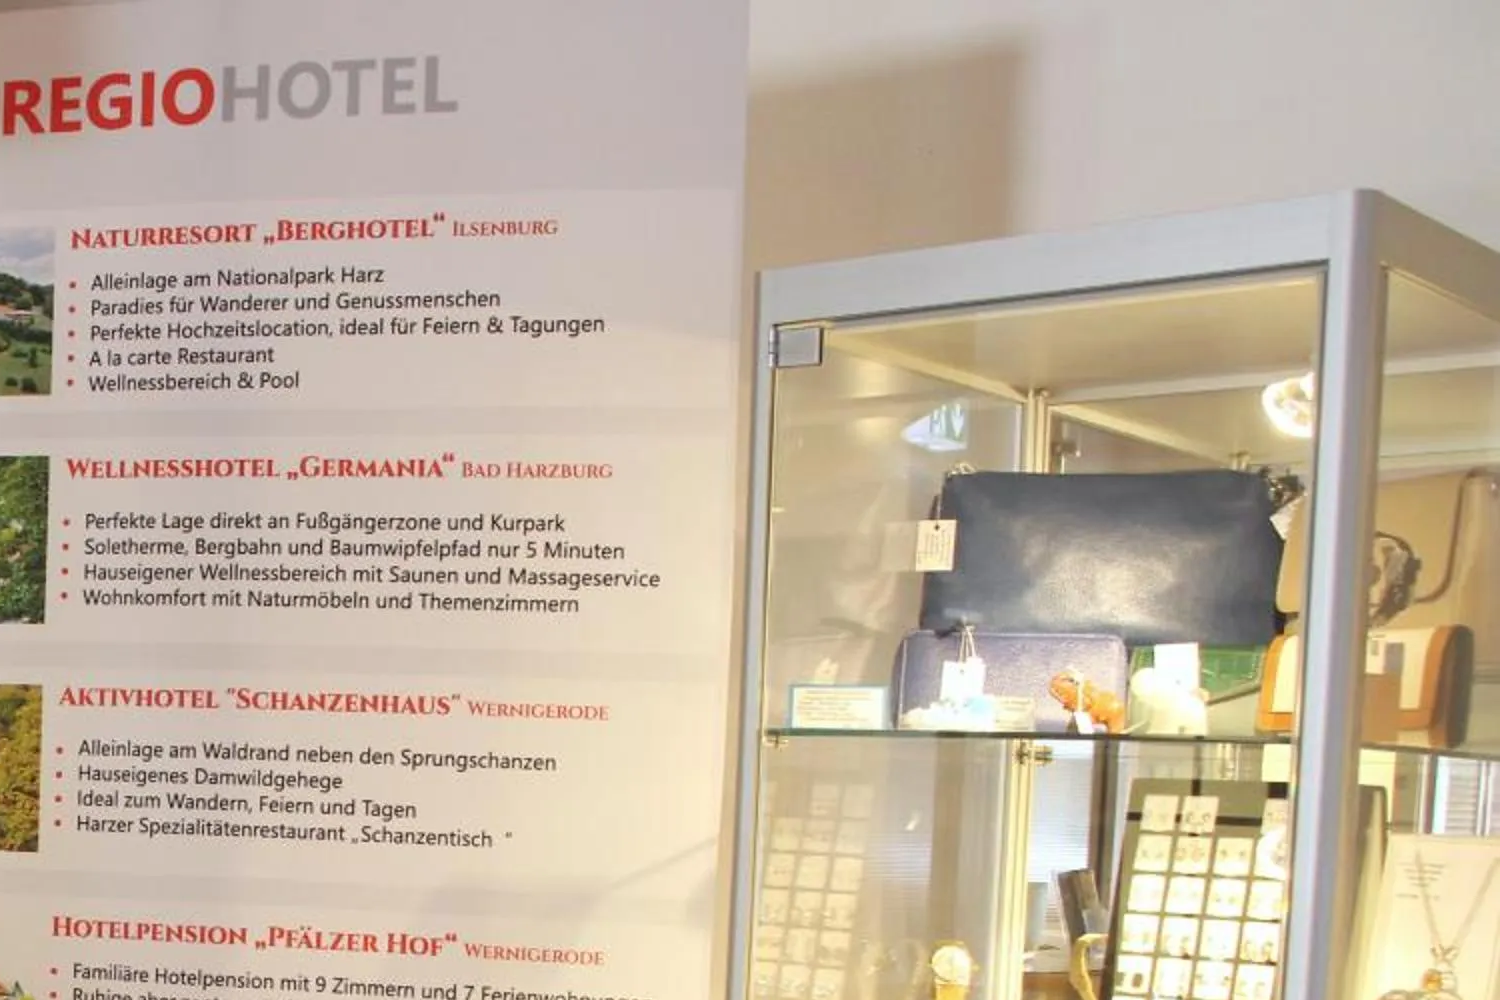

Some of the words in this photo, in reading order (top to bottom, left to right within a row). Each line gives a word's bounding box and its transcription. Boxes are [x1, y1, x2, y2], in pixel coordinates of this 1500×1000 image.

[2, 56, 458, 137] REGIOHOTEL
[71, 224, 258, 250] NATURRESORT
[452, 219, 558, 237] ILSENBURG
[90, 272, 179, 293] Alleinlage
[183, 273, 211, 288] am
[217, 265, 335, 289] Nationalpark
[341, 265, 386, 284] Harz
[91, 297, 164, 317] Paradies
[169, 296, 195, 314] für
[200, 294, 289, 313] Wanderer
[294, 292, 331, 311] und
[335, 289, 501, 310] Genussmenschen
[90, 323, 161, 342] Perfekte
[167, 319, 333, 339] Hochzeitslocation,
[339, 317, 384, 336] ideal
[390, 316, 418, 335] für
[423, 316, 481, 335] Feiern
[486, 315, 504, 335] &
[509, 315, 605, 339] Tagungen
[65, 458, 280, 480] WELLNESSHOTEL
[462, 461, 501, 479] BAD
[506, 461, 613, 479] HARZBURG
[85, 512, 157, 531] Perfekte
[162, 512, 205, 534] Lage
[209, 512, 263, 529] direkt
[268, 515, 290, 530] an
[296, 511, 442, 535] Fußgängerzone
[447, 513, 485, 532] und
[490, 513, 565, 536] Kurpark
[84, 537, 189, 557] Soletherme,
[195, 537, 282, 560] Bergbahn
[288, 538, 323, 556] und
[329, 539, 481, 562] Baumwipfelpfad
[487, 544, 520, 558] nur
[526, 541, 537, 558] 5
[543, 540, 625, 560] Minuten
[58, 685, 220, 709] AKTIVHOTEL
[467, 700, 609, 721] WERNIGERODE
[78, 739, 164, 763] Alleinlage
[169, 744, 197, 759] am
[202, 740, 290, 762] Waldrand
[296, 745, 353, 764] neben
[359, 746, 395, 766] den
[400, 748, 557, 773] Sprungschanzen
[78, 764, 189, 787] Hauseigenes
[195, 768, 343, 794] Damwildgehege
[52, 912, 248, 945] HOTELPENSION
[464, 943, 604, 966] WERNIGERODE
[73, 962, 150, 983] Familiäre
[154, 967, 275, 991] Hotelpension
[280, 974, 311, 992] mit
[315, 976, 327, 993] 9
[332, 976, 415, 999] Zimmern
[421, 983, 457, 1000] und
